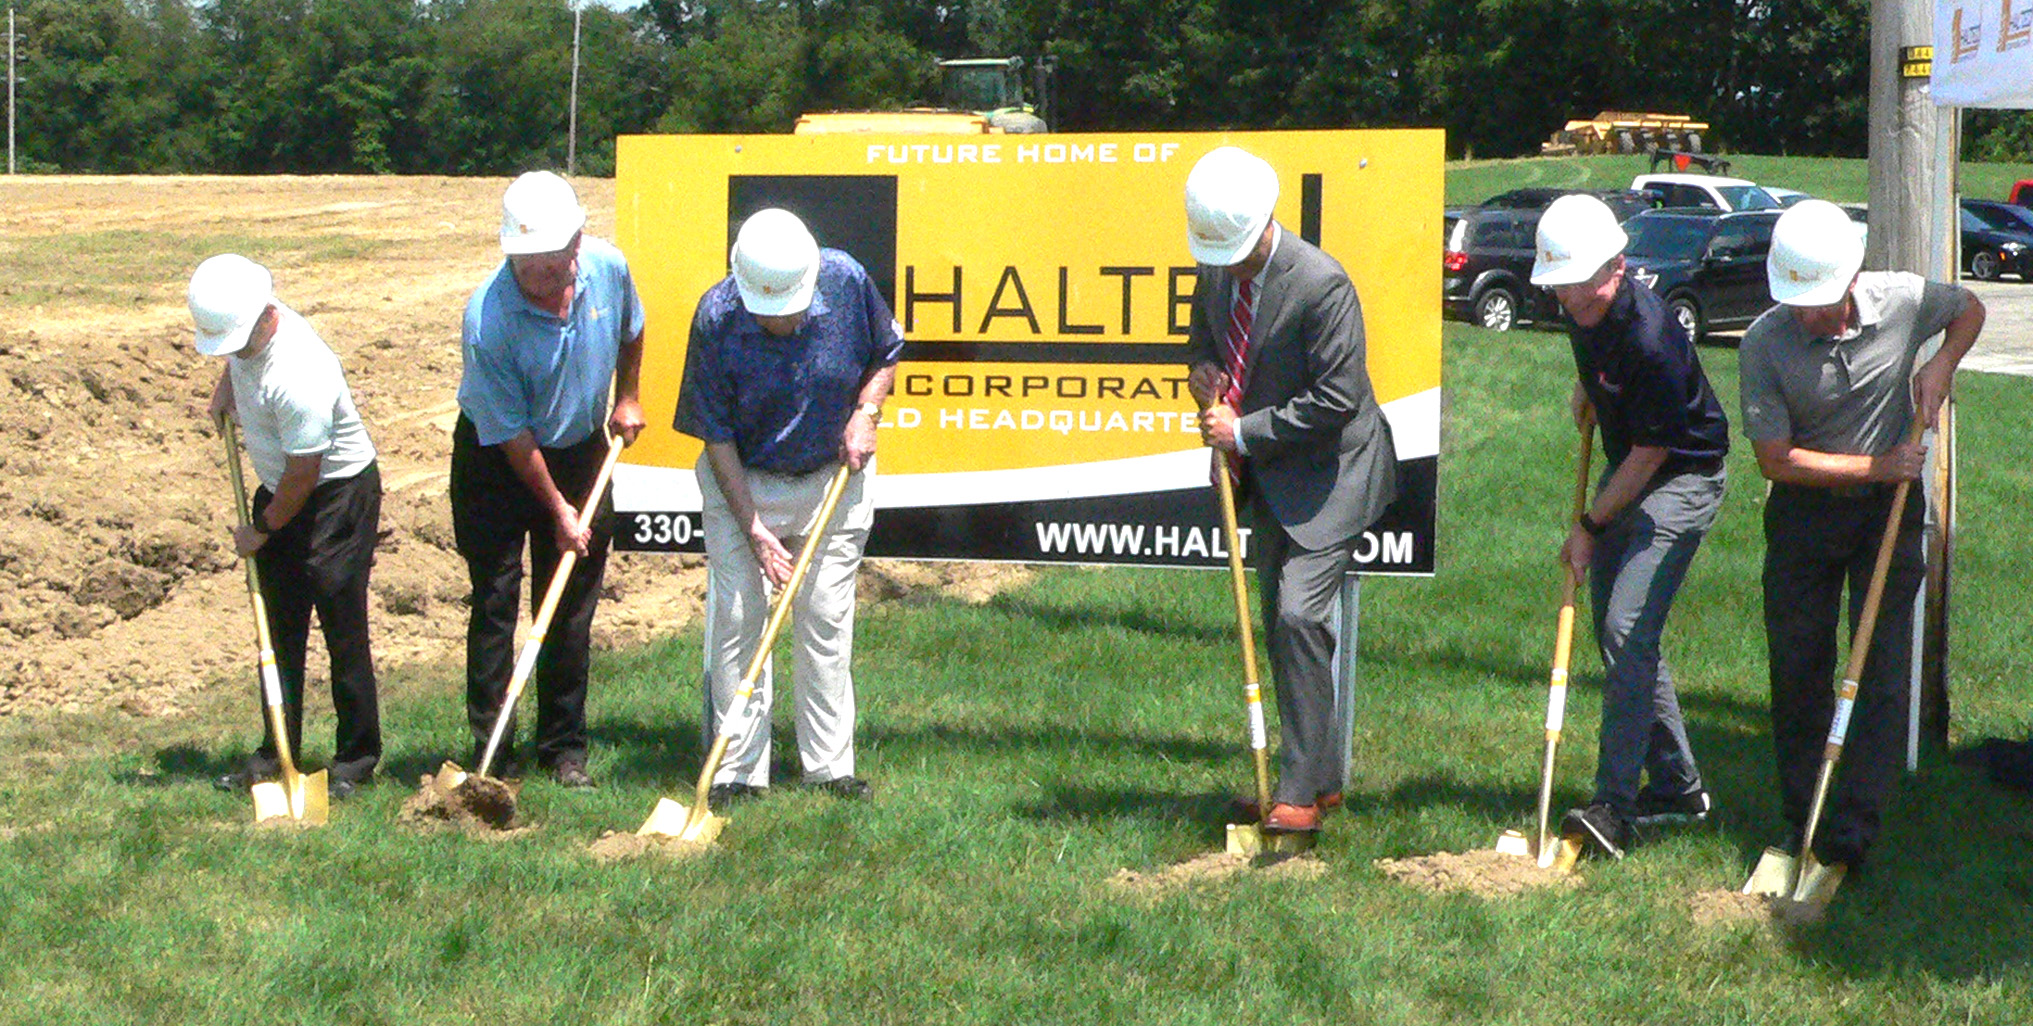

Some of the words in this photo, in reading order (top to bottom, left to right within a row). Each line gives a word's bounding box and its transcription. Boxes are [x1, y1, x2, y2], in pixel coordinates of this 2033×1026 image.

[866, 144, 1001, 164] FUTURE
[1017, 143, 1118, 163] HOME
[1133, 142, 1180, 163] OF
[904, 265, 1198, 336] HALTE
[887, 374, 1189, 400] CORPORAT
[938, 408, 1202, 435] HEADQUARTE
